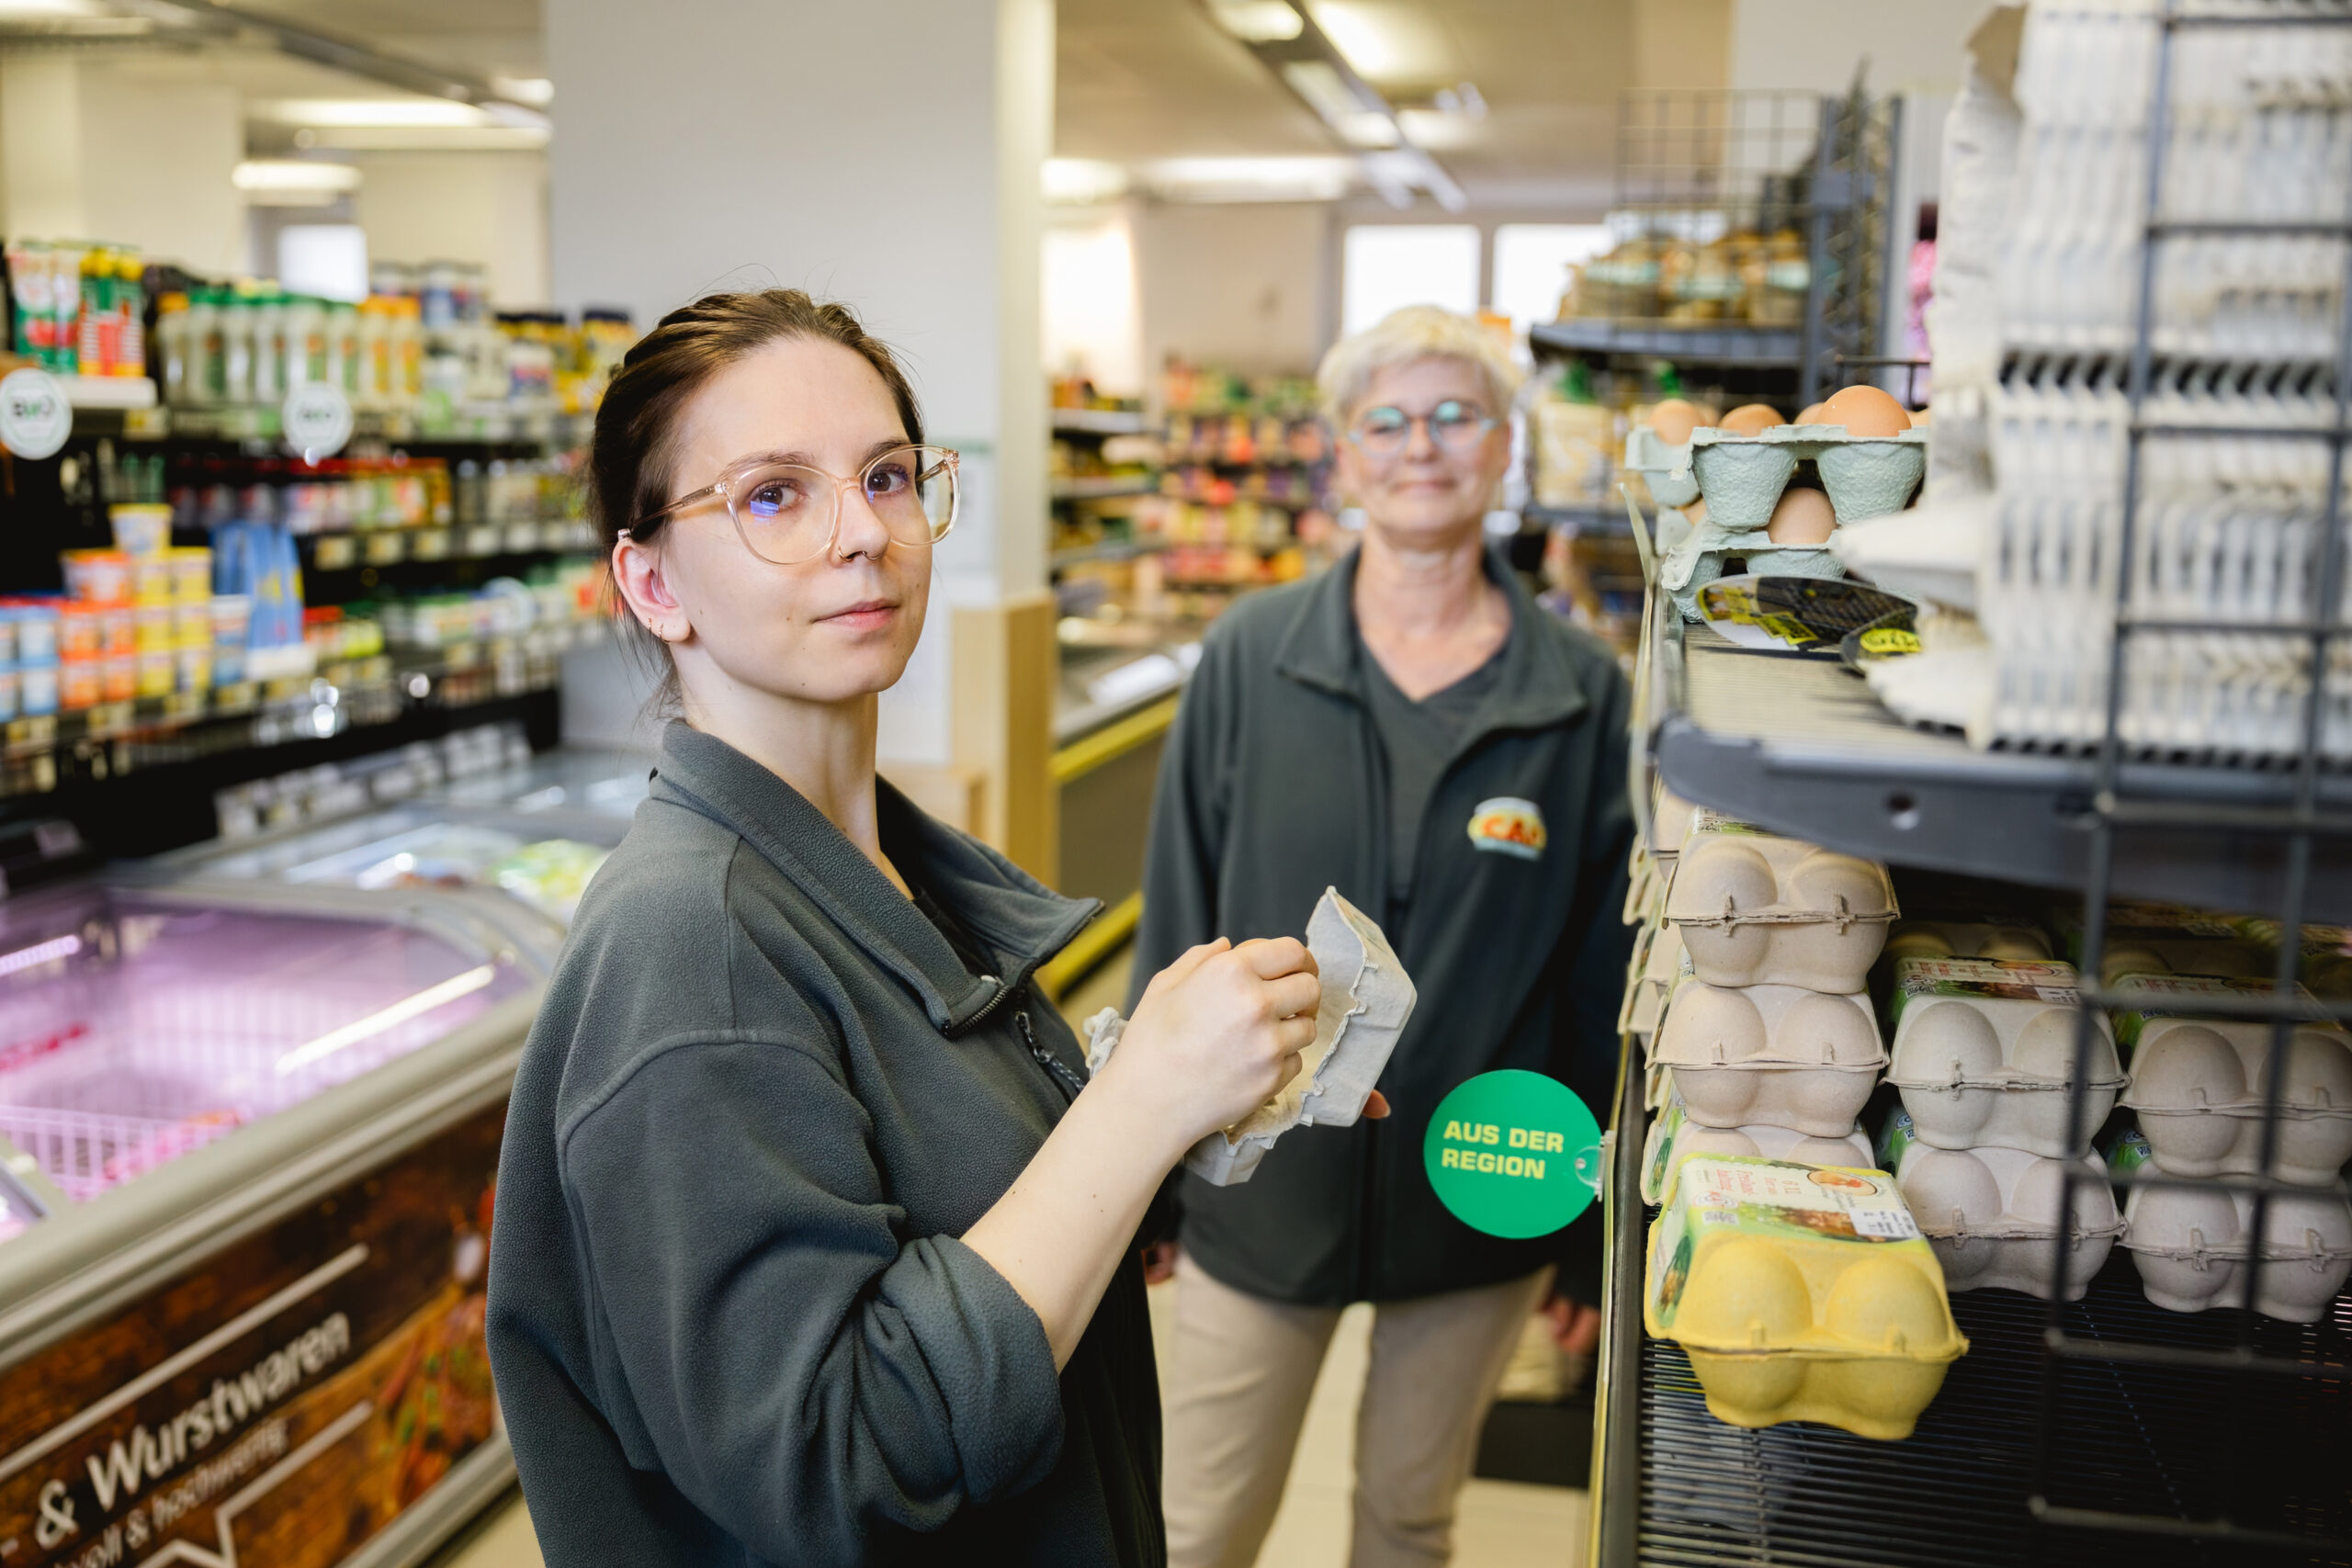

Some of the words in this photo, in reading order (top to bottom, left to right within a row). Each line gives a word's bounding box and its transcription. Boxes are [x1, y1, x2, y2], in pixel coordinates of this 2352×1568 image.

[1443, 1120, 1500, 1145] AUS
[1509, 1127, 1565, 1154] DER
[1442, 1147, 1545, 1179] REGION
[35, 1478, 80, 1550] &
[85, 1311, 351, 1512] Wurstwaren
